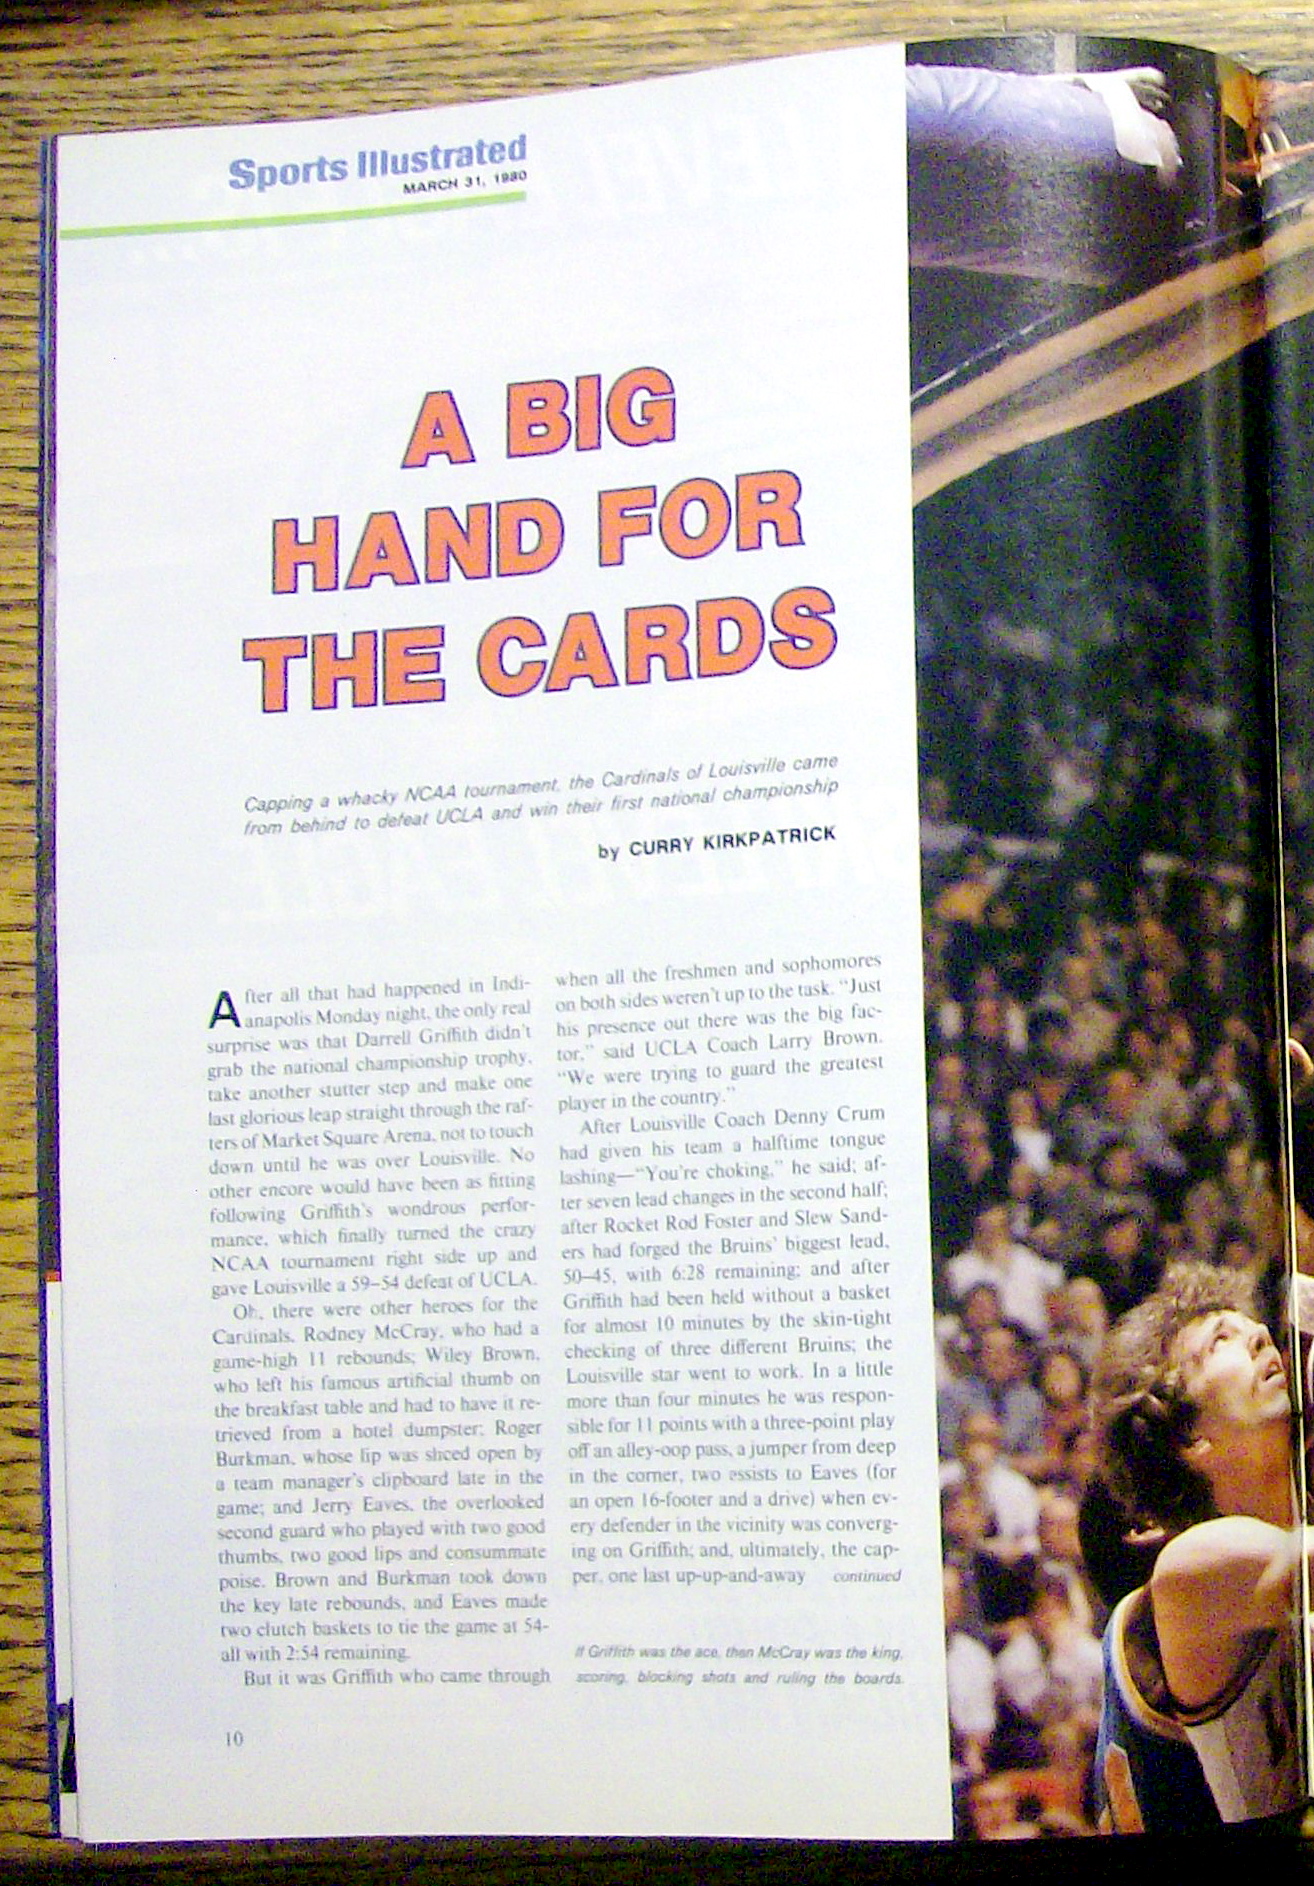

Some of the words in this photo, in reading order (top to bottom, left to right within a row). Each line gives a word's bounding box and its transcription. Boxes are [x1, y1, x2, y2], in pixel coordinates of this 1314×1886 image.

[228, 156, 348, 192] Sports
[357, 133, 526, 178] Illustrated
[402, 177, 458, 194] MARCH
[401, 391, 477, 470] A
[507, 367, 677, 460] BIG
[272, 499, 566, 596] HAND
[599, 470, 807, 569] FOR
[243, 626, 447, 715] THE
[477, 587, 839, 699] CARDS
[244, 794, 314, 813] Capping
[319, 796, 330, 807] a
[337, 789, 398, 806] whacky
[404, 784, 456, 801] NCAA
[568, 775, 594, 789] the
[601, 767, 679, 787] Cardinals
[686, 765, 702, 780] of
[708, 758, 786, 778] Louisville
[792, 756, 838, 770] came
[243, 820, 282, 835] from
[290, 815, 348, 833] behind
[354, 817, 370, 829] to
[376, 812, 428, 828] defeat
[435, 806, 482, 824] UCLA
[490, 803, 522, 820] and
[529, 801, 558, 817] win
[566, 799, 603, 814] their
[610, 796, 644, 810] first
[650, 788, 716, 807] national
[722, 778, 838, 801] championship
[597, 843, 620, 862] by
[628, 836, 694, 856] CURRY
[702, 824, 836, 850] KIRKPATRICK
[554, 968, 598, 987] when
[605, 967, 624, 984] all
[632, 965, 657, 982] the
[664, 960, 737, 980] freshmen
[744, 958, 774, 975] and
[781, 951, 881, 978] sophomores
[602, 1041, 634, 1059] said
[644, 1037, 697, 1057] UCLA
[706, 1034, 758, 1053] Coach
[768, 1031, 811, 1054] Larry
[207, 1084, 241, 1101] take
[248, 1081, 311, 1100] another
[318, 1081, 370, 1097] stutter
[377, 1080, 410, 1100] step
[416, 1077, 447, 1094] and
[454, 1075, 496, 1092] make
[503, 1078, 532, 1091] one
[579, 1116, 621, 1135] After
[629, 1112, 706, 1132] Louisville
[713, 1109, 765, 1128] Coach
[773, 1106, 828, 1130] Denny
[836, 1103, 885, 1122] Crum
[559, 1143, 588, 1160] had
[598, 1141, 641, 1163] given
[651, 1139, 674, 1156] his
[684, 1139, 722, 1155] team
[732, 1140, 741, 1152] a
[752, 1132, 819, 1151] halftime
[829, 1131, 886, 1152] tongue
[209, 1204, 286, 1226] following
[387, 1198, 466, 1217] wondrous
[480, 1196, 535, 1219] perfor-
[560, 1218, 598, 1235] after
[603, 1215, 658, 1233] Rocket
[665, 1213, 698, 1231] Rod
[704, 1211, 753, 1229] Foster
[758, 1210, 788, 1227] and
[794, 1208, 832, 1225] Slew
[839, 1205, 888, 1224] Sand-
[210, 1253, 268, 1270] NCAA
[280, 1252, 374, 1269] tournament
[385, 1249, 423, 1270] right
[433, 1248, 465, 1264] side
[476, 1251, 498, 1268] up
[507, 1246, 536, 1262] and
[562, 1291, 622, 1310] Griffith
[629, 1290, 659, 1308] had
[666, 1289, 703, 1306] been
[710, 1287, 744, 1305] held
[751, 1285, 813, 1303] without
[820, 1289, 830, 1301] a
[838, 1282, 890, 1300] basket
[563, 1341, 636, 1364] checking
[644, 1341, 662, 1357] of
[670, 1339, 711, 1356] three
[719, 1337, 787, 1355] different
[865, 1333, 892, 1350] the
[213, 1375, 248, 1392] who
[256, 1375, 281, 1392] left
[290, 1374, 313, 1391] his
[320, 1372, 379, 1390] famous
[386, 1371, 452, 1389] artificial
[460, 1369, 513, 1387] thumb
[519, 1373, 540, 1386] on
[216, 1522, 273, 1539] second
[278, 1521, 326, 1543] guard
[330, 1520, 366, 1537] who
[371, 1519, 425, 1541] played
[429, 1519, 465, 1536] with
[470, 1520, 501, 1535] two
[505, 1518, 545, 1539] good
[274, 1570, 328, 1587] Brown
[337, 1570, 367, 1586] and
[376, 1569, 450, 1586] Burkman
[458, 1568, 493, 1585] took
[501, 1567, 546, 1584] down
[220, 1644, 240, 1661] all
[244, 1644, 281, 1661] with
[285, 1644, 319, 1660] 2:54
[638, 1648, 666, 1657] was
[669, 1646, 691, 1657] the
[724, 1646, 754, 1658] then
[756, 1645, 810, 1661] McCray
[814, 1649, 842, 1659] was
[845, 1646, 867, 1658] the
[243, 1668, 271, 1685] But
[278, 1670, 289, 1685] it
[295, 1672, 326, 1684] was
[331, 1667, 393, 1684] Griffith
[399, 1667, 434, 1684] who
[439, 1671, 482, 1683] came
[487, 1666, 550, 1687] through
[636, 1670, 693, 1685] blocking
[700, 1670, 736, 1683] shots
[742, 1672, 769, 1684] and
[776, 1671, 816, 1687] ruling
[823, 1671, 845, 1684] the
[226, 1730, 244, 1746] 10
